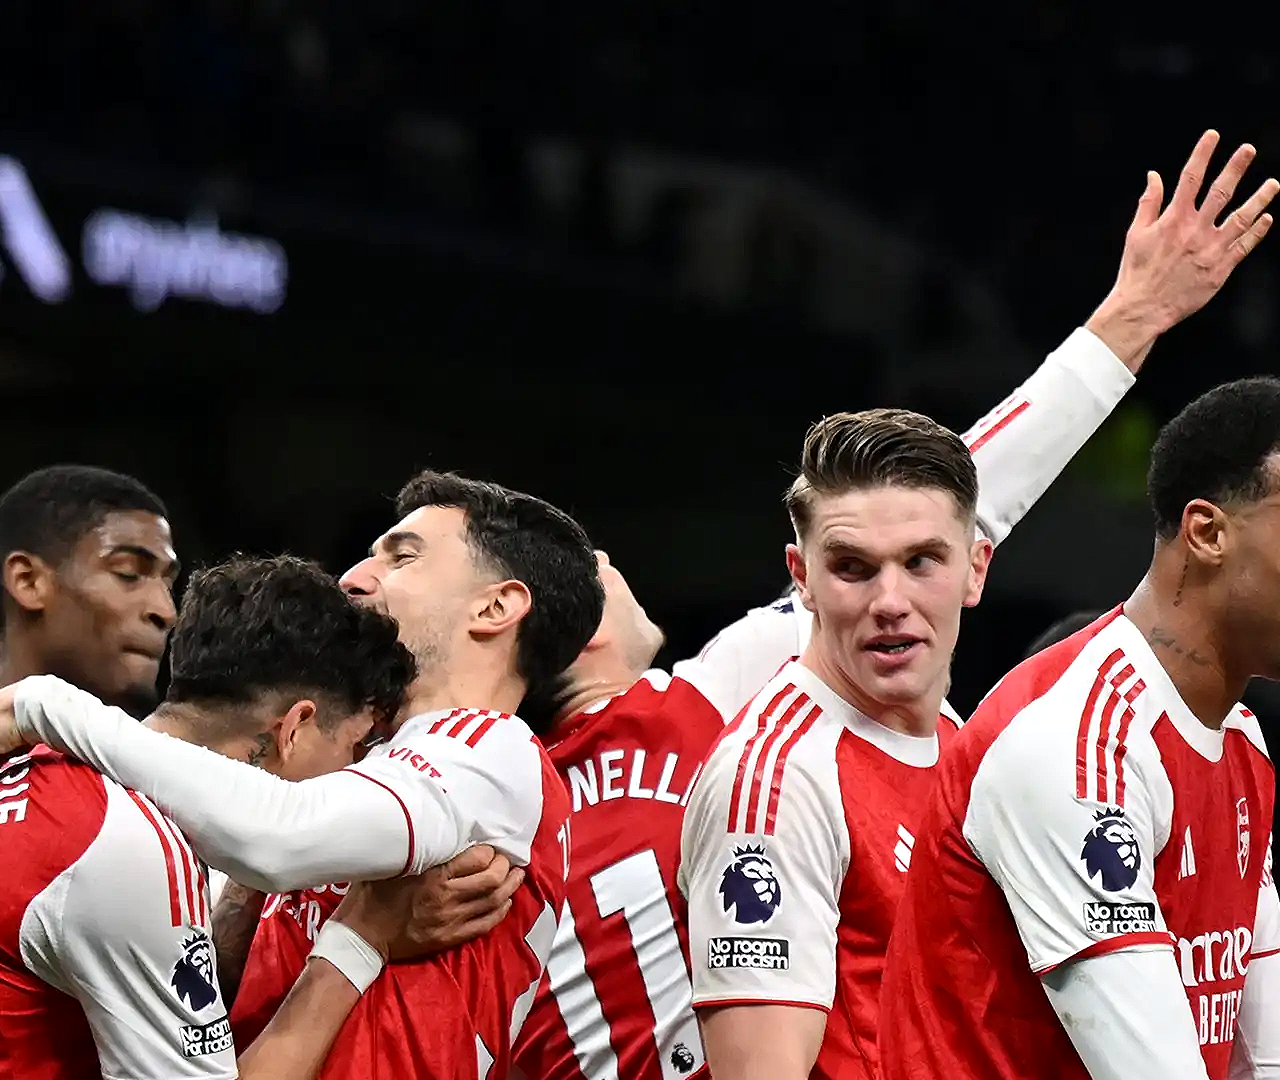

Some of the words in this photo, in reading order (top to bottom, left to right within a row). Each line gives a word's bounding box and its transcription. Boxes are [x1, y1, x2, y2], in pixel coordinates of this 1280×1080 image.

[567, 748, 703, 813] NELLI
[1084, 903, 1111, 920] No
[1114, 905, 1150, 920] room
[708, 938, 731, 954] No
[733, 940, 781, 956] room
[732, 953, 789, 970] racism
[179, 1026, 203, 1043] No
